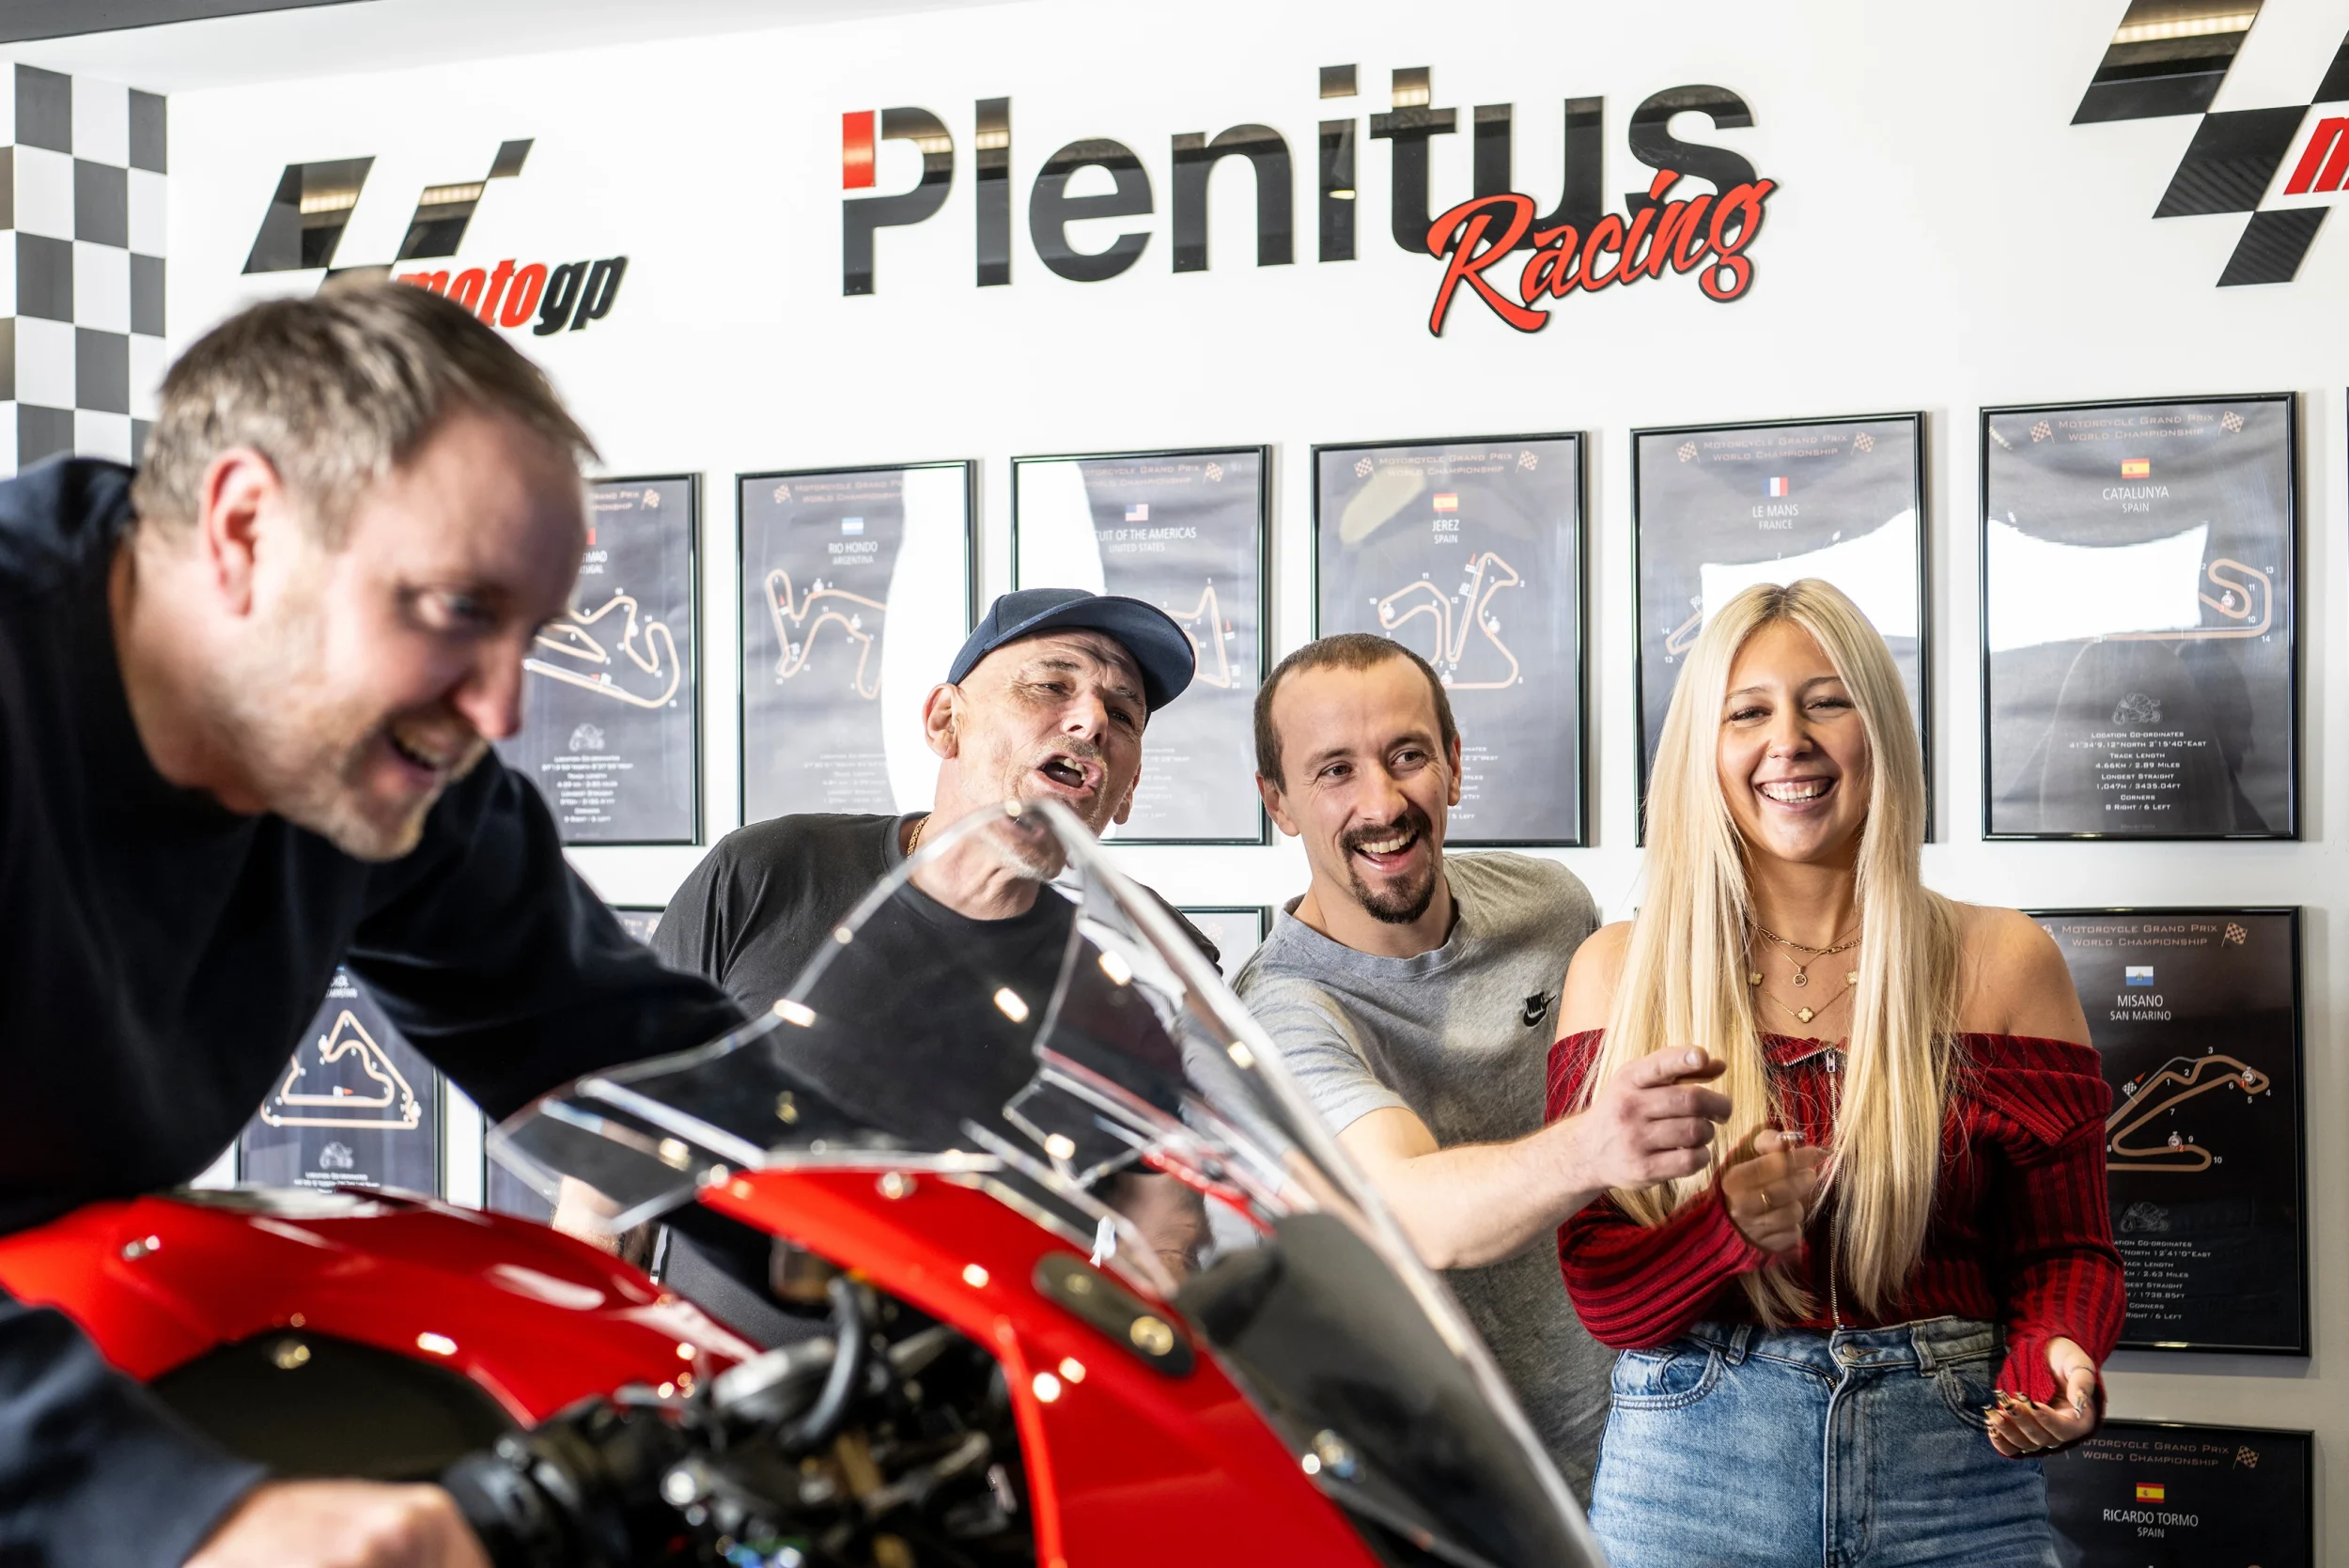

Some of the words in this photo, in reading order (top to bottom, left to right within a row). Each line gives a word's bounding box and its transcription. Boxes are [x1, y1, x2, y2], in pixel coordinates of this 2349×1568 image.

[842, 64, 1759, 296] Plenitus
[1424, 169, 1779, 336] Racing
[2059, 418, 2135, 428] MOTORCYCLE
[2139, 415, 2183, 425] GRAND
[2187, 413, 2215, 422] PRIX
[2068, 432, 2109, 442] WORLD
[2114, 428, 2205, 440] CHAMPIONSHIP
[1703, 439, 1773, 449] MOTORCYCLE
[1779, 437, 1818, 446] GRAND
[1822, 434, 1848, 442] PRIX
[1378, 456, 1445, 466] MOTORCYCLE
[1449, 454, 1486, 462] GRAND
[1489, 452, 1513, 460] PRIX
[1713, 453, 1751, 461] WORLD
[1755, 448, 1839, 459] CHAMPIONSHIP
[1083, 468, 1136, 476] OTORCYCLE
[1140, 466, 1174, 474] GRAND
[1177, 464, 1201, 473] PRIX
[1387, 469, 1423, 477] WORLD
[1427, 465, 1504, 475] CHAMPIONSHIP
[855, 481, 887, 489] GRAND
[1120, 477, 1192, 487] CHAMPIONSHIP
[802, 494, 834, 504] WORLD
[2102, 486, 2170, 501] CATALUNYA
[1752, 505, 1764, 518] LE
[1767, 504, 1799, 517] MANS
[2122, 503, 2150, 513] SPAIN
[1431, 519, 1460, 532] JEREZ
[1758, 519, 1794, 531] FRANCE
[1115, 529, 1128, 541] OF
[1129, 528, 1147, 540] THE
[1148, 527, 1197, 540] AMERICAS
[1434, 534, 1458, 545] SPAIN
[828, 542, 844, 554] RIO
[846, 541, 879, 553] HONDO
[1109, 543, 1137, 553] UNITED
[1138, 542, 1165, 552] STATES
[832, 555, 874, 566] ARGENTINA
[1776, 551, 1782, 560] 2
[2265, 566, 2274, 574] 13
[1519, 580, 1525, 588] 2
[2248, 582, 2255, 592] 11
[2247, 615, 2256, 624] 10
[1661, 627, 1670, 635] 14
[2261, 634, 2270, 643] 14
[2061, 924, 2139, 934] MOTORCYCLE
[2143, 924, 2186, 933] GRAND
[2190, 924, 2217, 933] PRIX
[2072, 938, 2113, 947] WORLD
[2119, 938, 2208, 947] CHAMPIONSHIP
[2117, 994, 2164, 1007] MISANO
[2109, 1010, 2129, 1021] SAN
[2132, 1010, 2171, 1021] MARINO
[2208, 1046, 2214, 1054] 3
[2184, 1068, 2190, 1077] 2
[2247, 1095, 2253, 1104] 5
[2170, 1108, 2176, 1116] 7
[2188, 1135, 2194, 1143] 9
[2213, 1156, 2222, 1164] 10
[2082, 1438, 2150, 1450] OTORCYCLE
[2155, 1442, 2197, 1452] GRAND
[2202, 1444, 2230, 1454] PRIX
[2082, 1451, 2123, 1461] WORLD
[2129, 1453, 2219, 1467] CHAMPIONSHIP
[2103, 1508, 2155, 1524] RICARDO
[2156, 1512, 2199, 1528] TORMO
[2137, 1527, 2165, 1538] SPAIN
